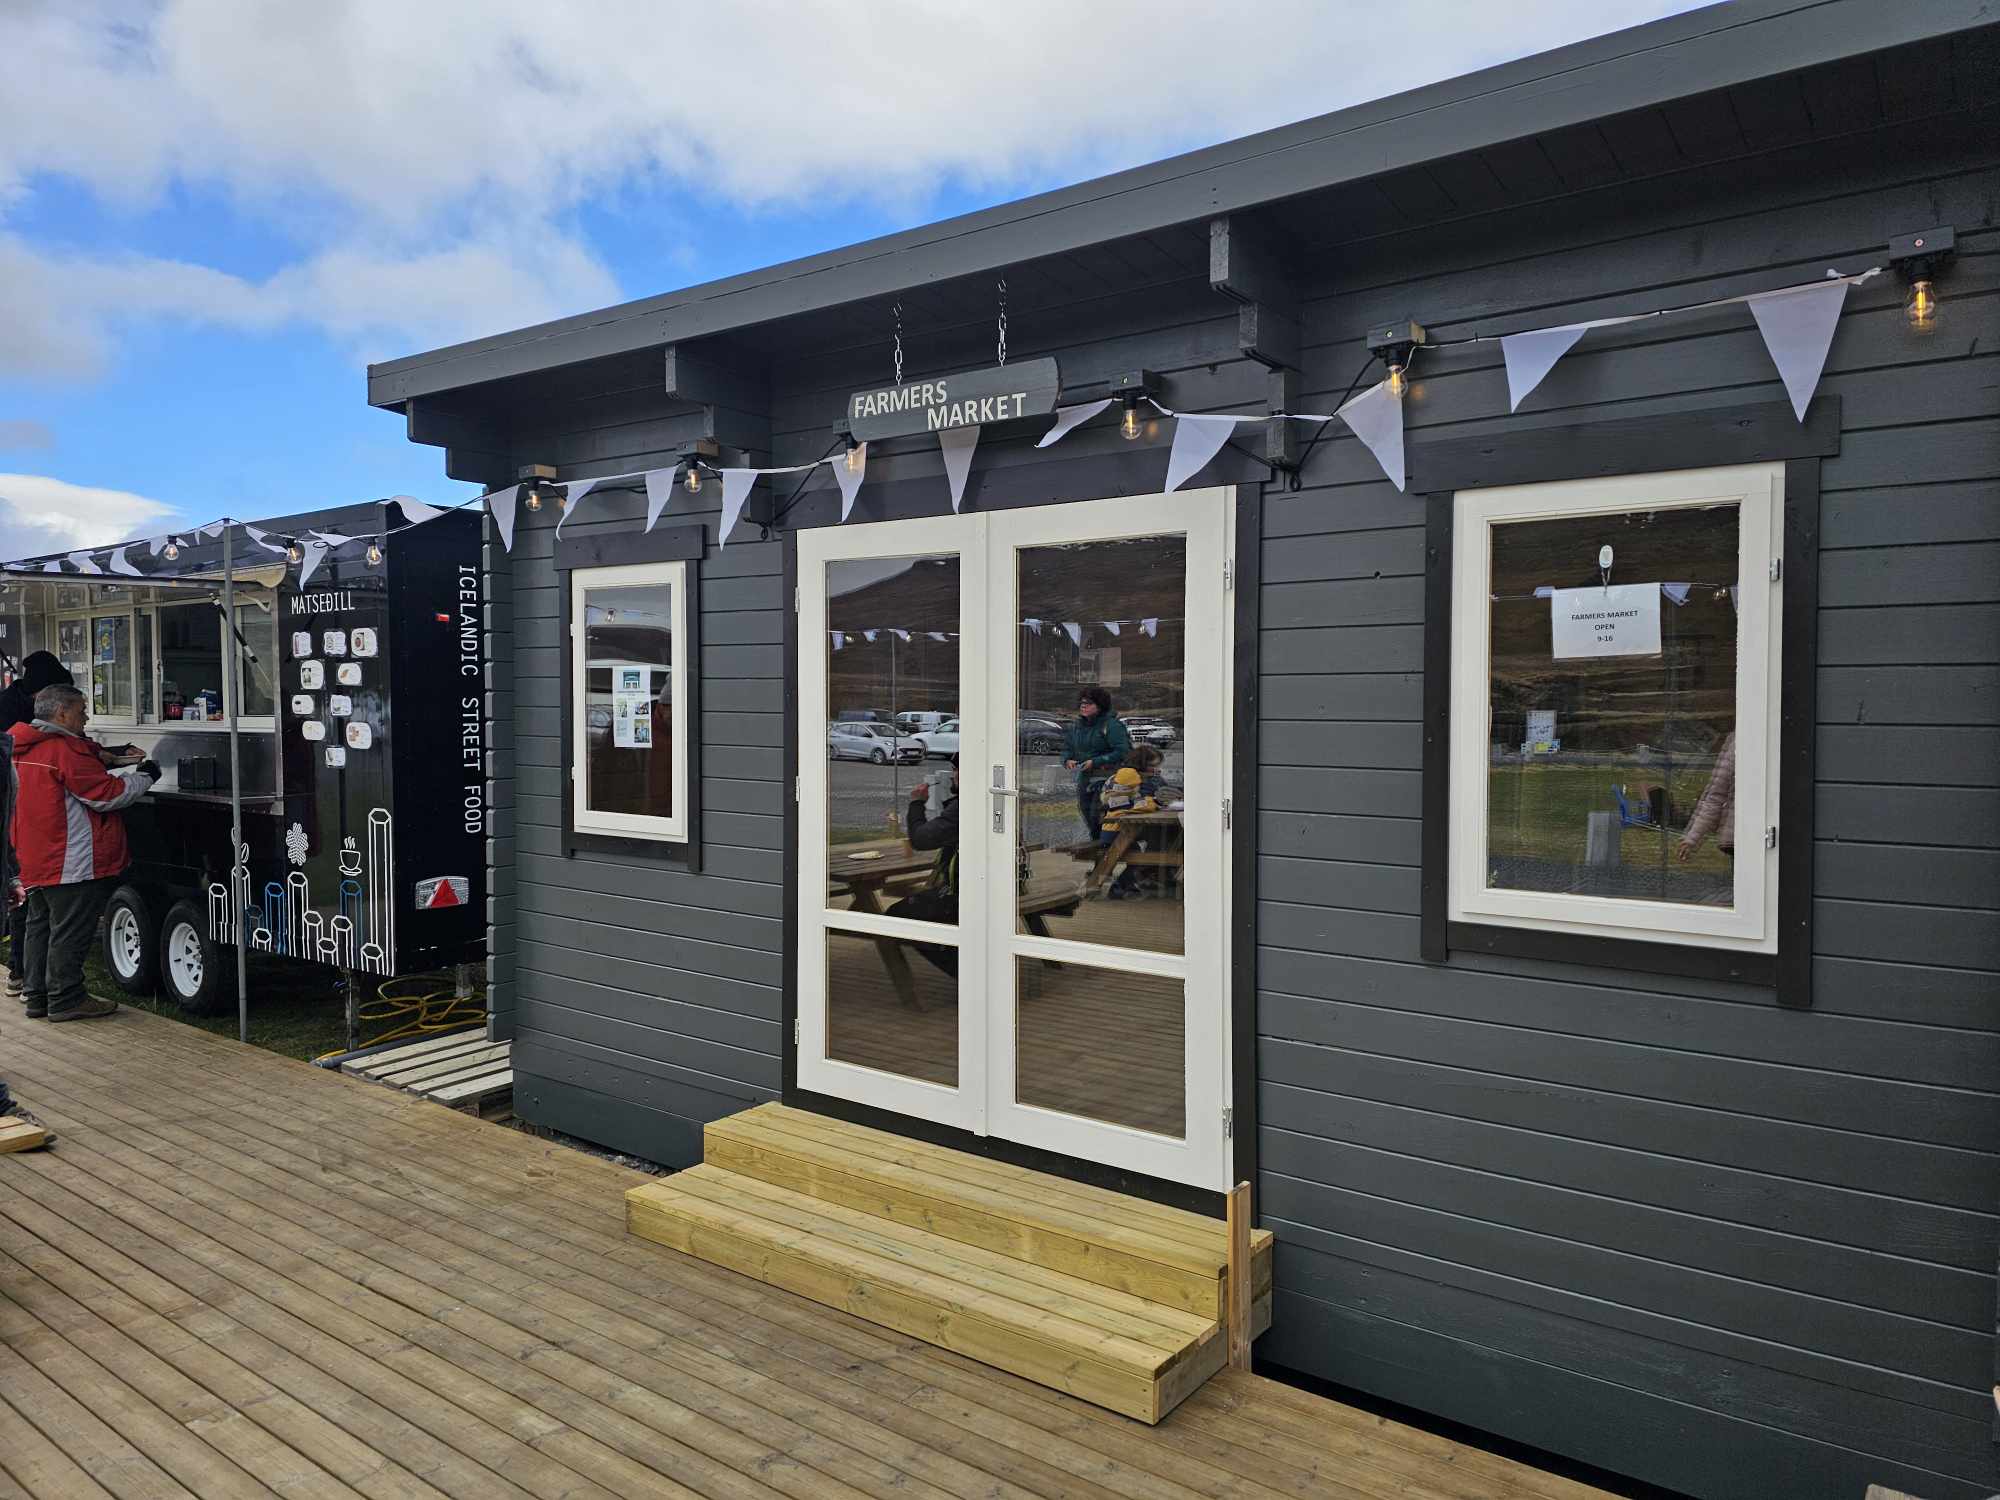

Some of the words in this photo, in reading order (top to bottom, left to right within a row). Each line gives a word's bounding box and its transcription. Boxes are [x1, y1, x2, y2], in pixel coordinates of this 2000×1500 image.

[855, 381, 947, 418] FARMERS
[927, 393, 1026, 430] MARKET
[291, 591, 355, 614] MATSEÐILL
[459, 565, 478, 676] ICELANDIC
[1571, 613, 1605, 621] FARMERS
[1607, 610, 1638, 619] MARKET
[462, 697, 480, 771] STREET
[464, 785, 482, 833] FOOD
